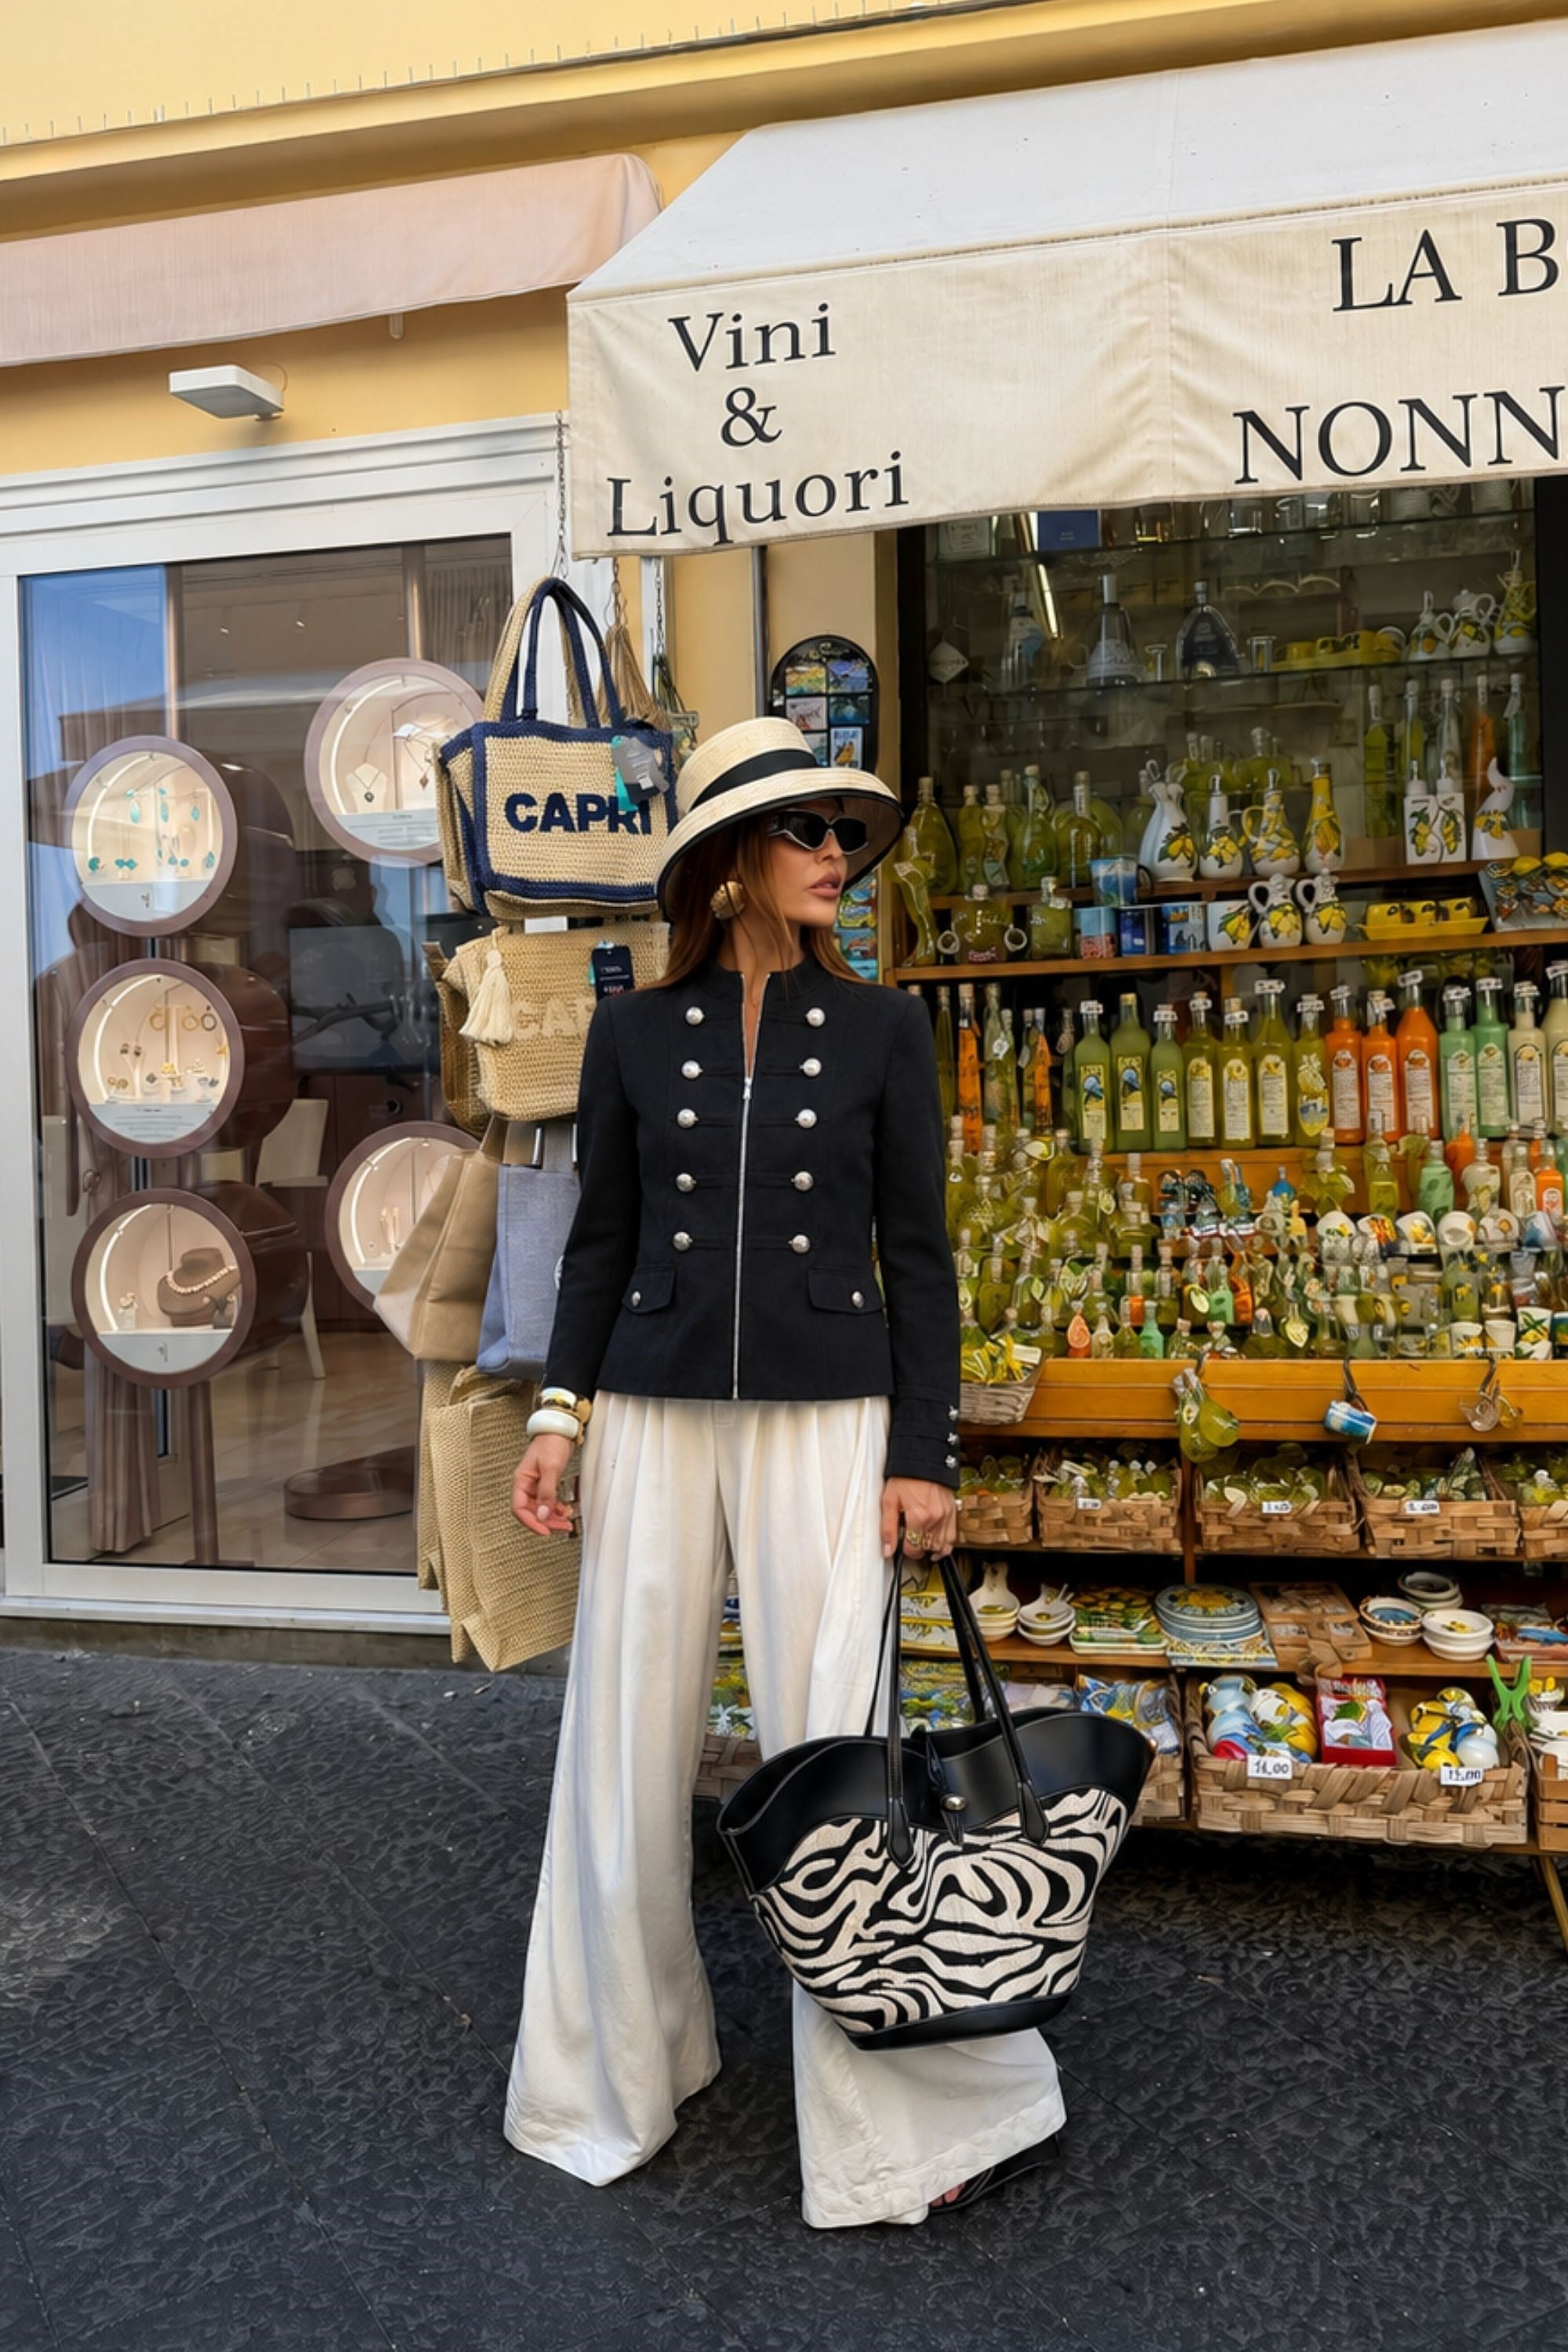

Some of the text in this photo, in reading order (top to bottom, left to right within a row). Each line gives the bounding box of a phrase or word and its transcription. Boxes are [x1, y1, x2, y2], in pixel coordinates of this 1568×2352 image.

[1331, 219, 1559, 312] LA B
[668, 303, 836, 372] Vini
[720, 387, 782, 447] &
[1232, 386, 1566, 485] NONN
[607, 451, 909, 546] Liquori
[504, 792, 652, 835] CAPRI
